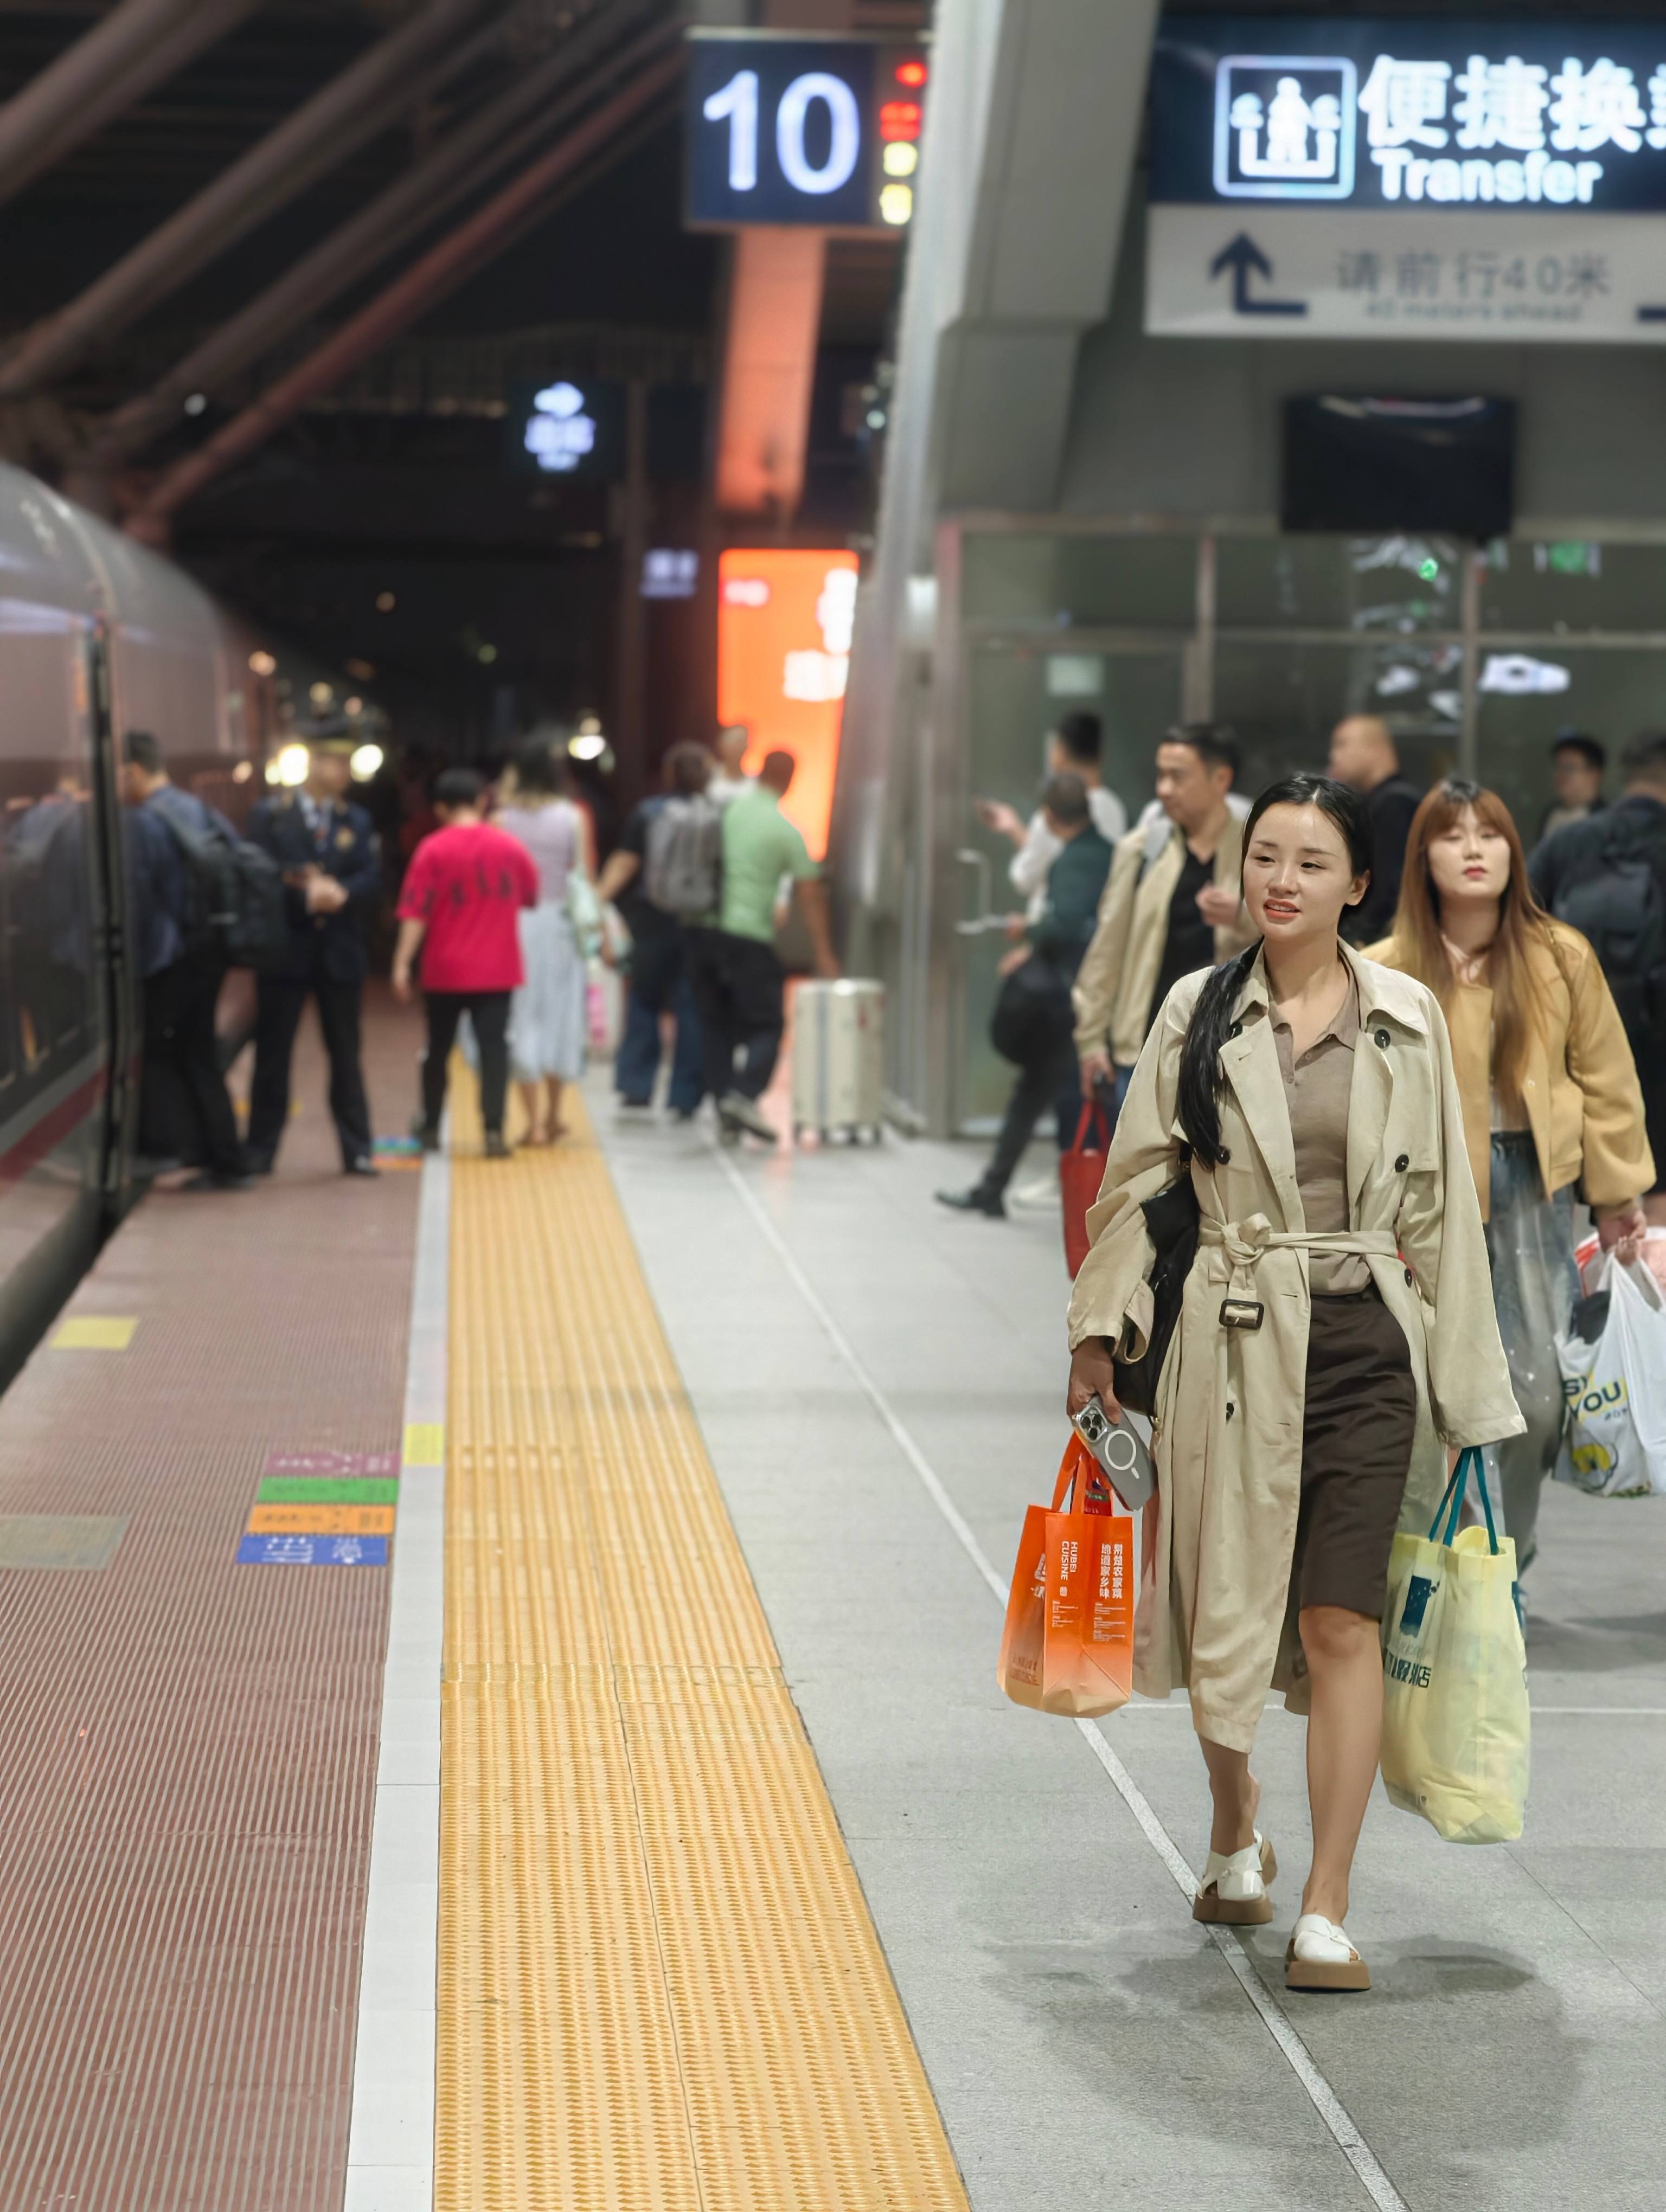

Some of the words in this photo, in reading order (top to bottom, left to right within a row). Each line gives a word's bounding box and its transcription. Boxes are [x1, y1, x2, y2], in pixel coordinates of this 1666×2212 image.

[1358, 54, 1666, 152] 便捷换
[703, 70, 860, 194] 10
[1370, 149, 1604, 203] Transfer
[1060, 1541, 1069, 1581] CUISINE
[1069, 1541, 1078, 1572] HUBEI
